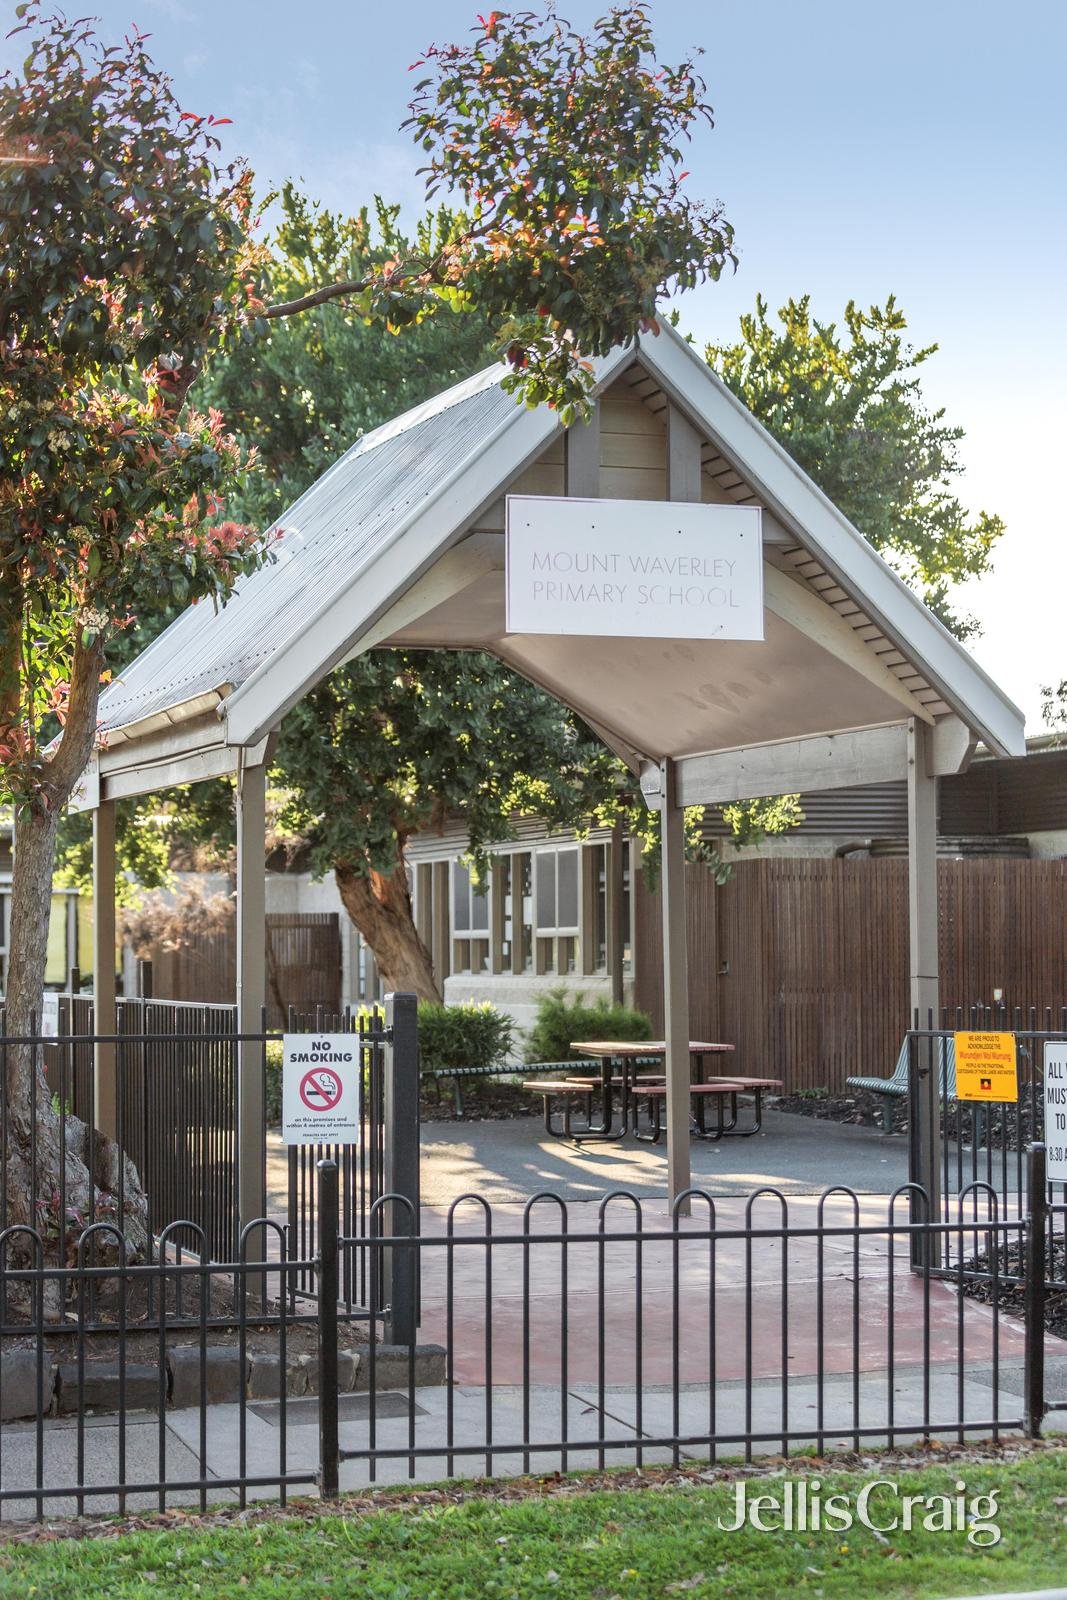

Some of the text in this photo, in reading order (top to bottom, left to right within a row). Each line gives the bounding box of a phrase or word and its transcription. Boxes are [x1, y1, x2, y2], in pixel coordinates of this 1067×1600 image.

[532, 551, 737, 578] MOUNT WAVERLEY
[532, 580, 740, 608] PRIMARY SCHOOL
[311, 1041, 332, 1051] NO
[290, 1053, 353, 1063] SMOKING
[1048, 1062, 1063, 1079] ALL
[1055, 1113, 1066, 1130] TO
